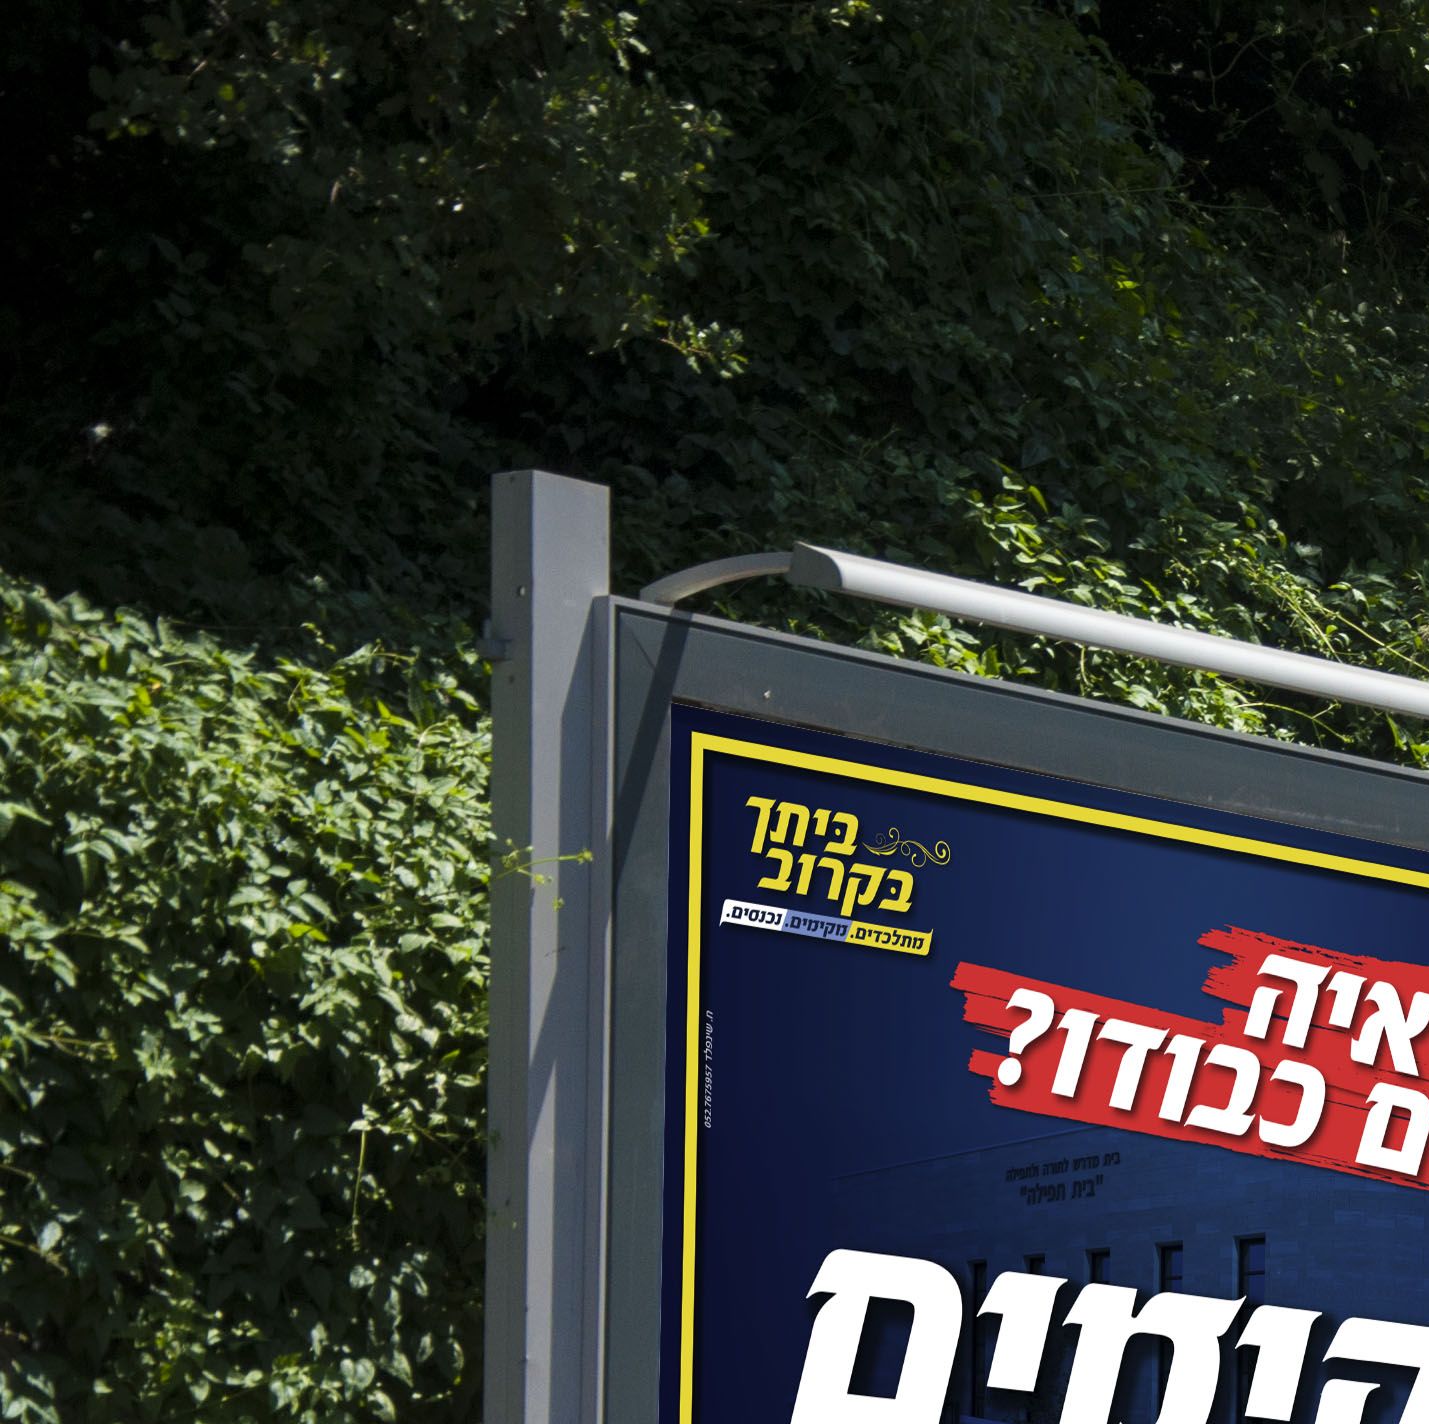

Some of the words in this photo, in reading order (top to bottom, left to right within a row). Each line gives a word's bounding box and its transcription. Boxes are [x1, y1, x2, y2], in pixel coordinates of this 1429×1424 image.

[726, 905, 782, 925] נכנסים.
[785, 915, 848, 938] מקימים.
[850, 926, 924, 950] מתלכדים.
[997, 987, 1326, 1148] כבודו?
